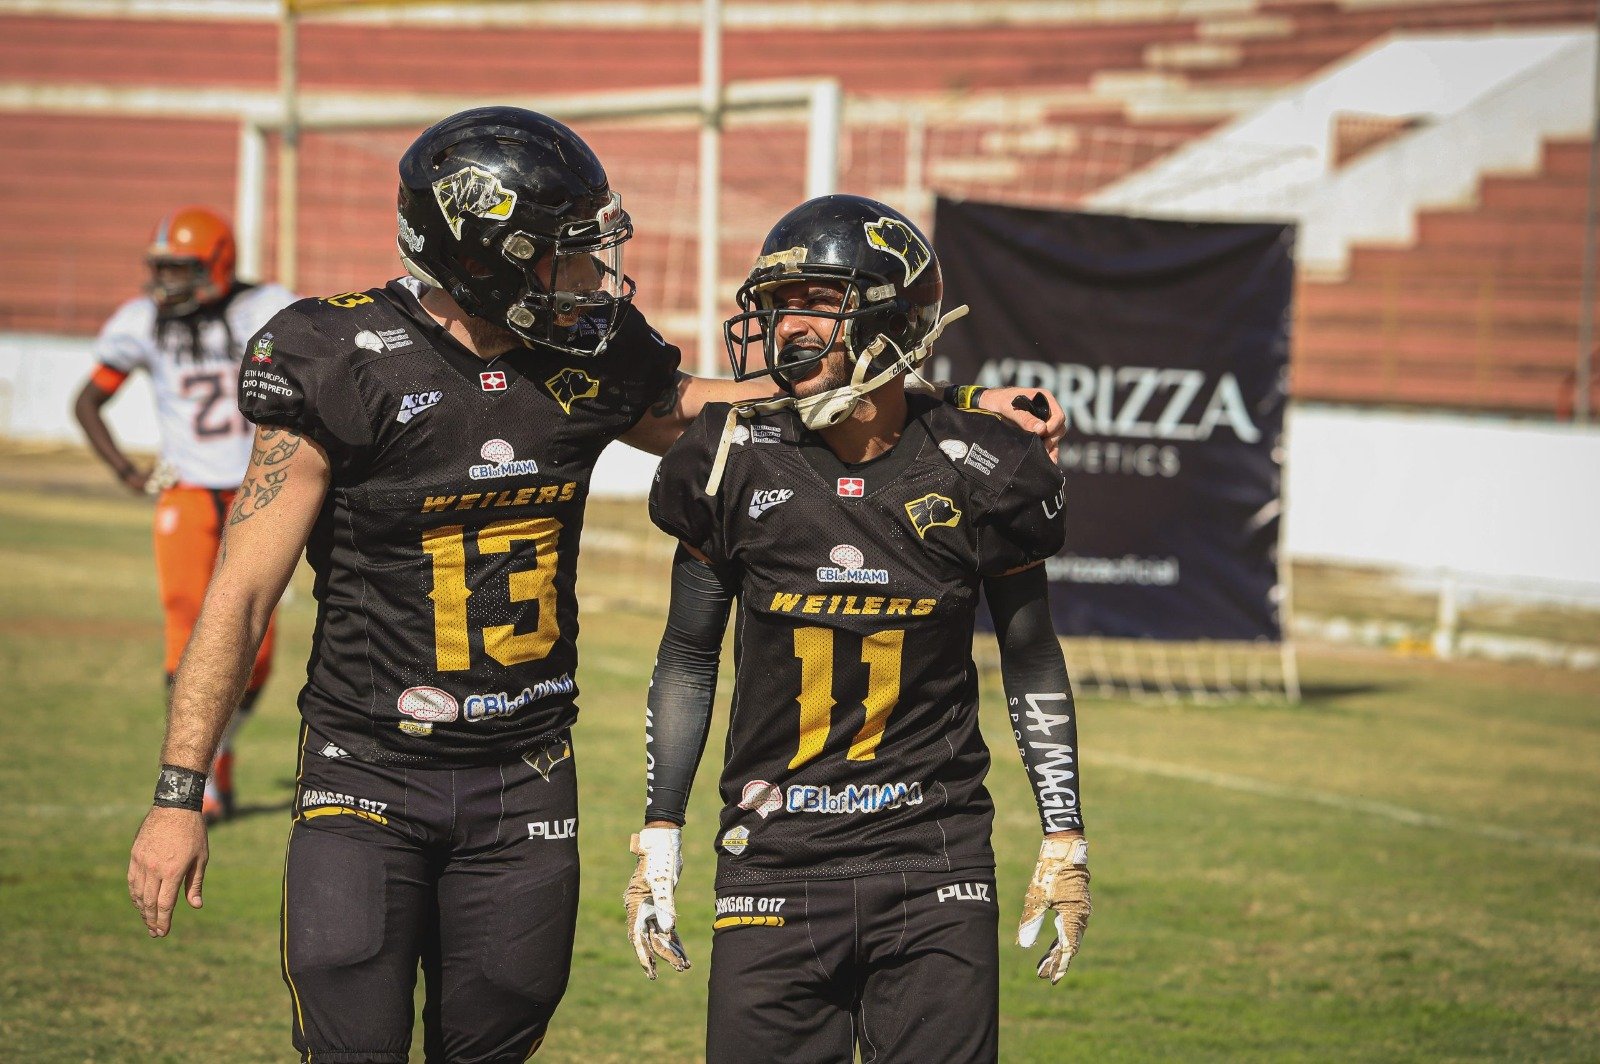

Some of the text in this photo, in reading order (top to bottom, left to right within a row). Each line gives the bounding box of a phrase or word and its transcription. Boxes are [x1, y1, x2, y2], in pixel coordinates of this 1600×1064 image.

[319, 291, 375, 308] 3
[183, 371, 250, 438] 2
[420, 481, 577, 513] WEILERS
[421, 517, 564, 672] 13
[769, 592, 937, 616] WEILERS
[787, 626, 905, 770] 11
[1025, 692, 1070, 736] LA
[359, 798, 388, 815] 017
[757, 897, 786, 913] 017
